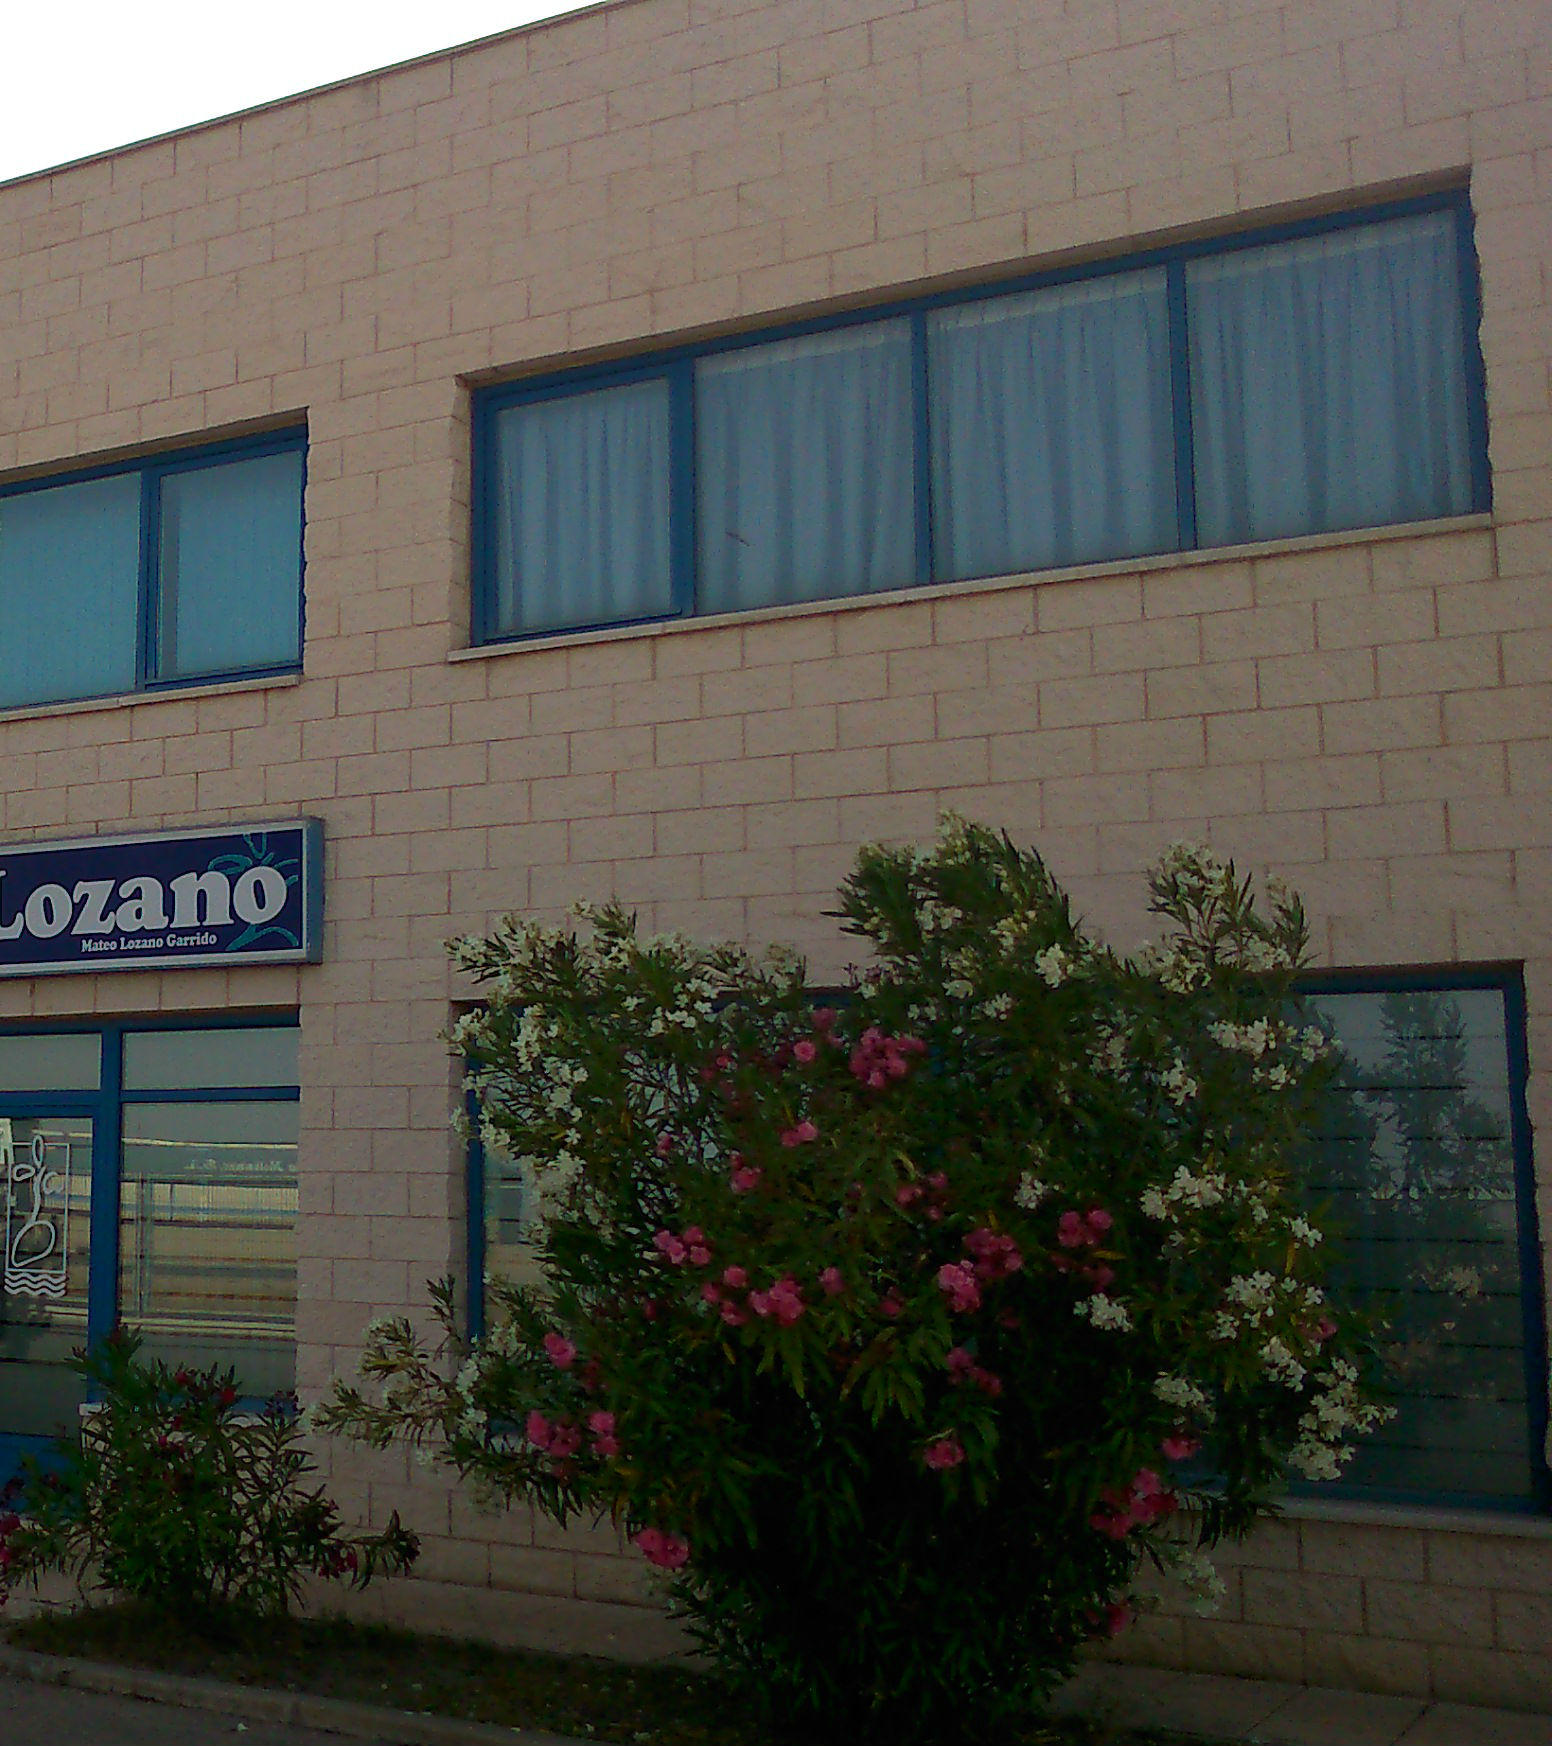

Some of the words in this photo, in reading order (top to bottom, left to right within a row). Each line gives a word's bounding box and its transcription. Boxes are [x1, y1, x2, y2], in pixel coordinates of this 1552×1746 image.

[81, 938, 117, 952] Mateo
[119, 936, 164, 950] Lozano
[166, 932, 218, 948] Garrido
